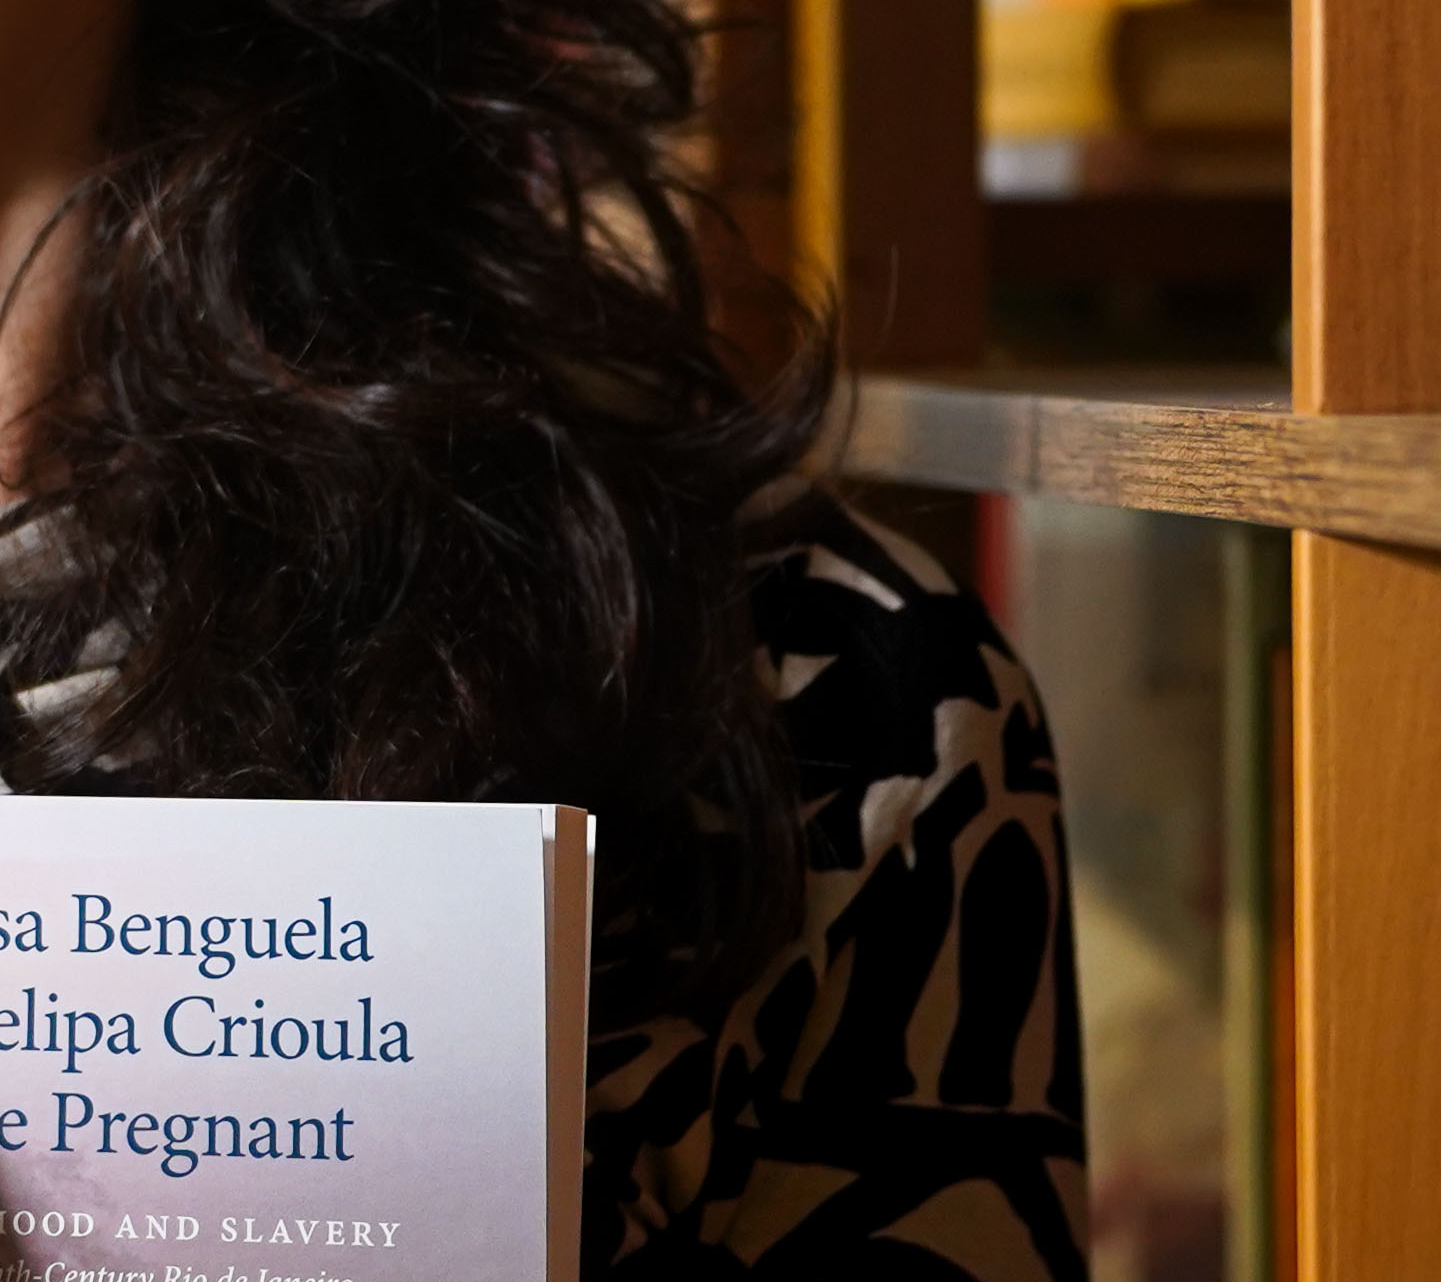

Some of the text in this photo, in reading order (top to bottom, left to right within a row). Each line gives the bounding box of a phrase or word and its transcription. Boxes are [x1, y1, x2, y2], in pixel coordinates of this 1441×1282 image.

[70, 894, 374, 979] Benguela
[163, 995, 414, 1063] Crioula
[50, 1091, 355, 1178] Pregnant
[115, 1214, 200, 1241] AND
[221, 1217, 401, 1248] SLAVERY
